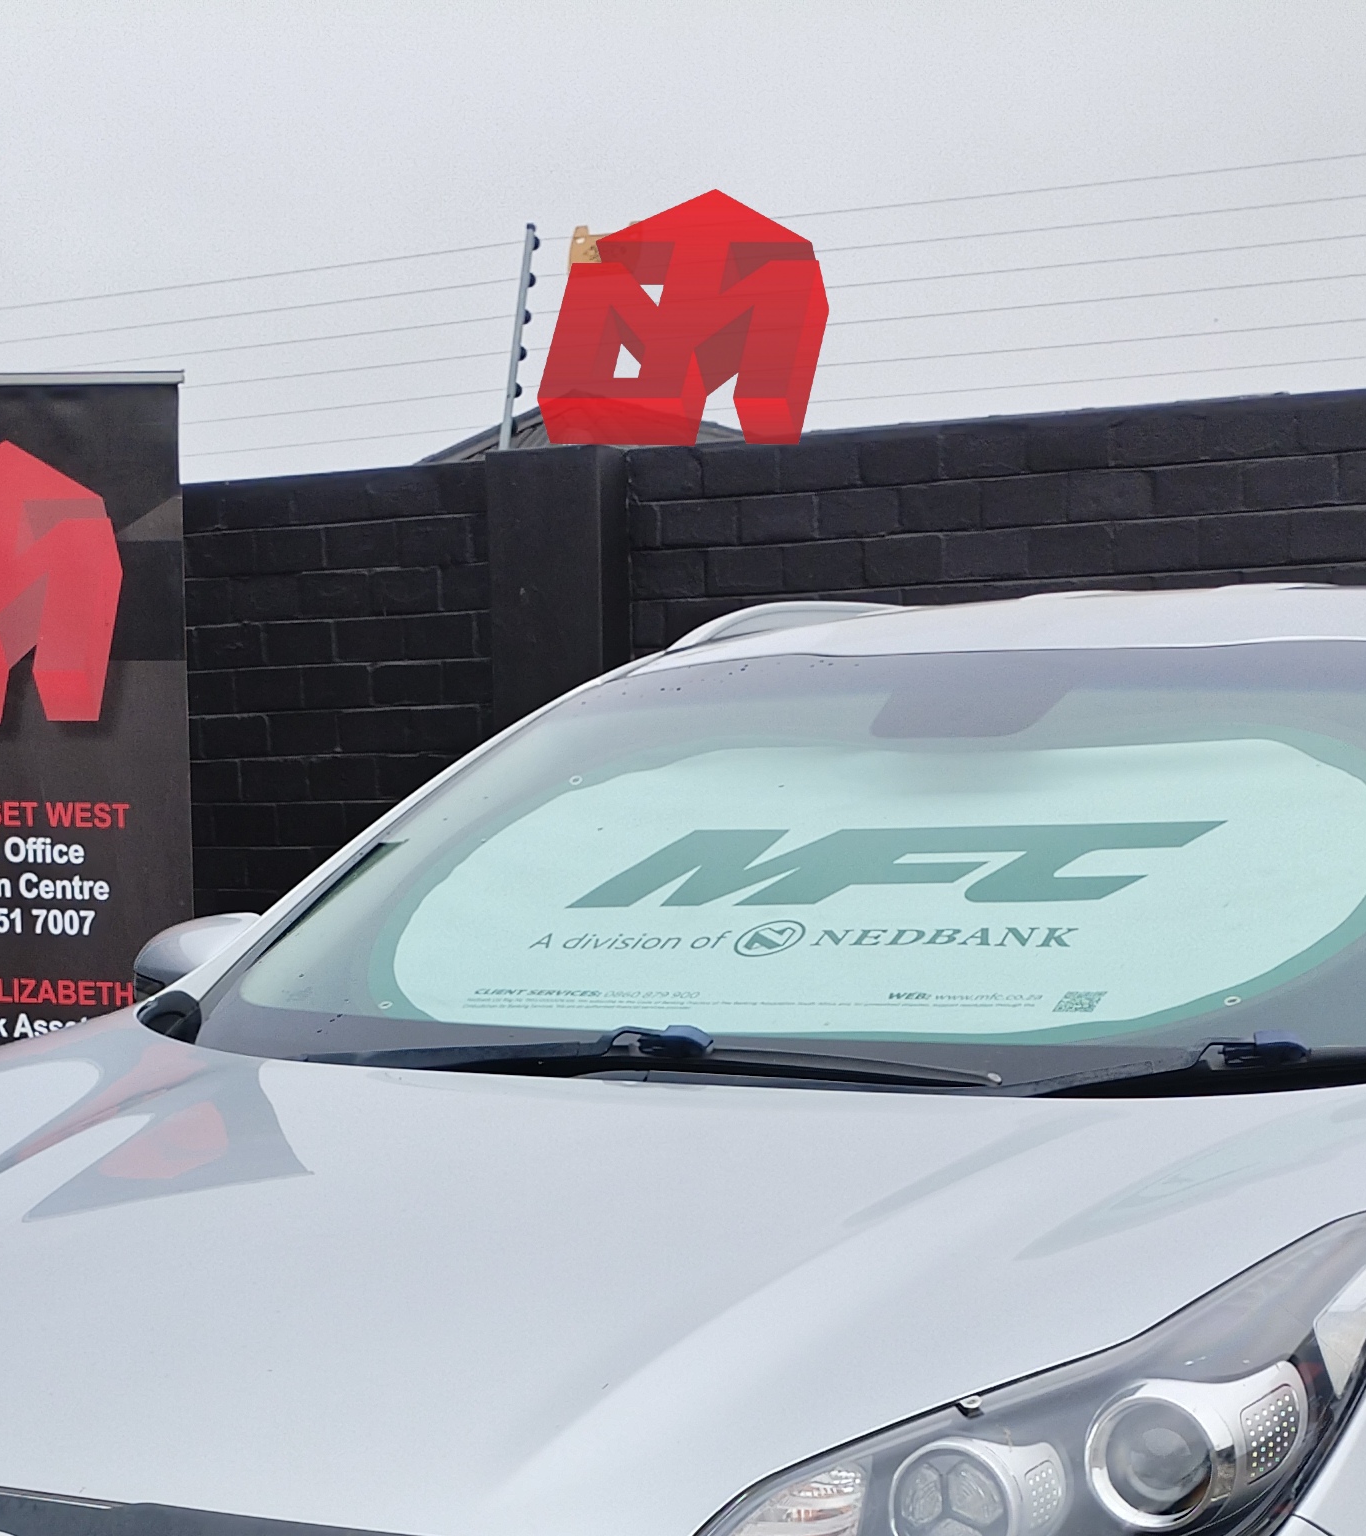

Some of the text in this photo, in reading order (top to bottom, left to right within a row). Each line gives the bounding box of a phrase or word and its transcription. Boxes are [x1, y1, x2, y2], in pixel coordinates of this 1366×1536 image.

[45, 802, 130, 829] WEST
[4, 836, 85, 864] Office
[565, 820, 1228, 908] MFC
[19, 872, 110, 901] Centre
[31, 908, 95, 936] 7007
[529, 933, 553, 949] A
[563, 933, 681, 950] division
[690, 930, 732, 950] of
[810, 926, 1079, 948] NEDBANK
[474, 987, 524, 996] CLIENT
[526, 988, 602, 998] SERVICES:
[888, 991, 1043, 1001] WEB: www.mfc.co.za
[13, 1013, 88, 1038] Ass
